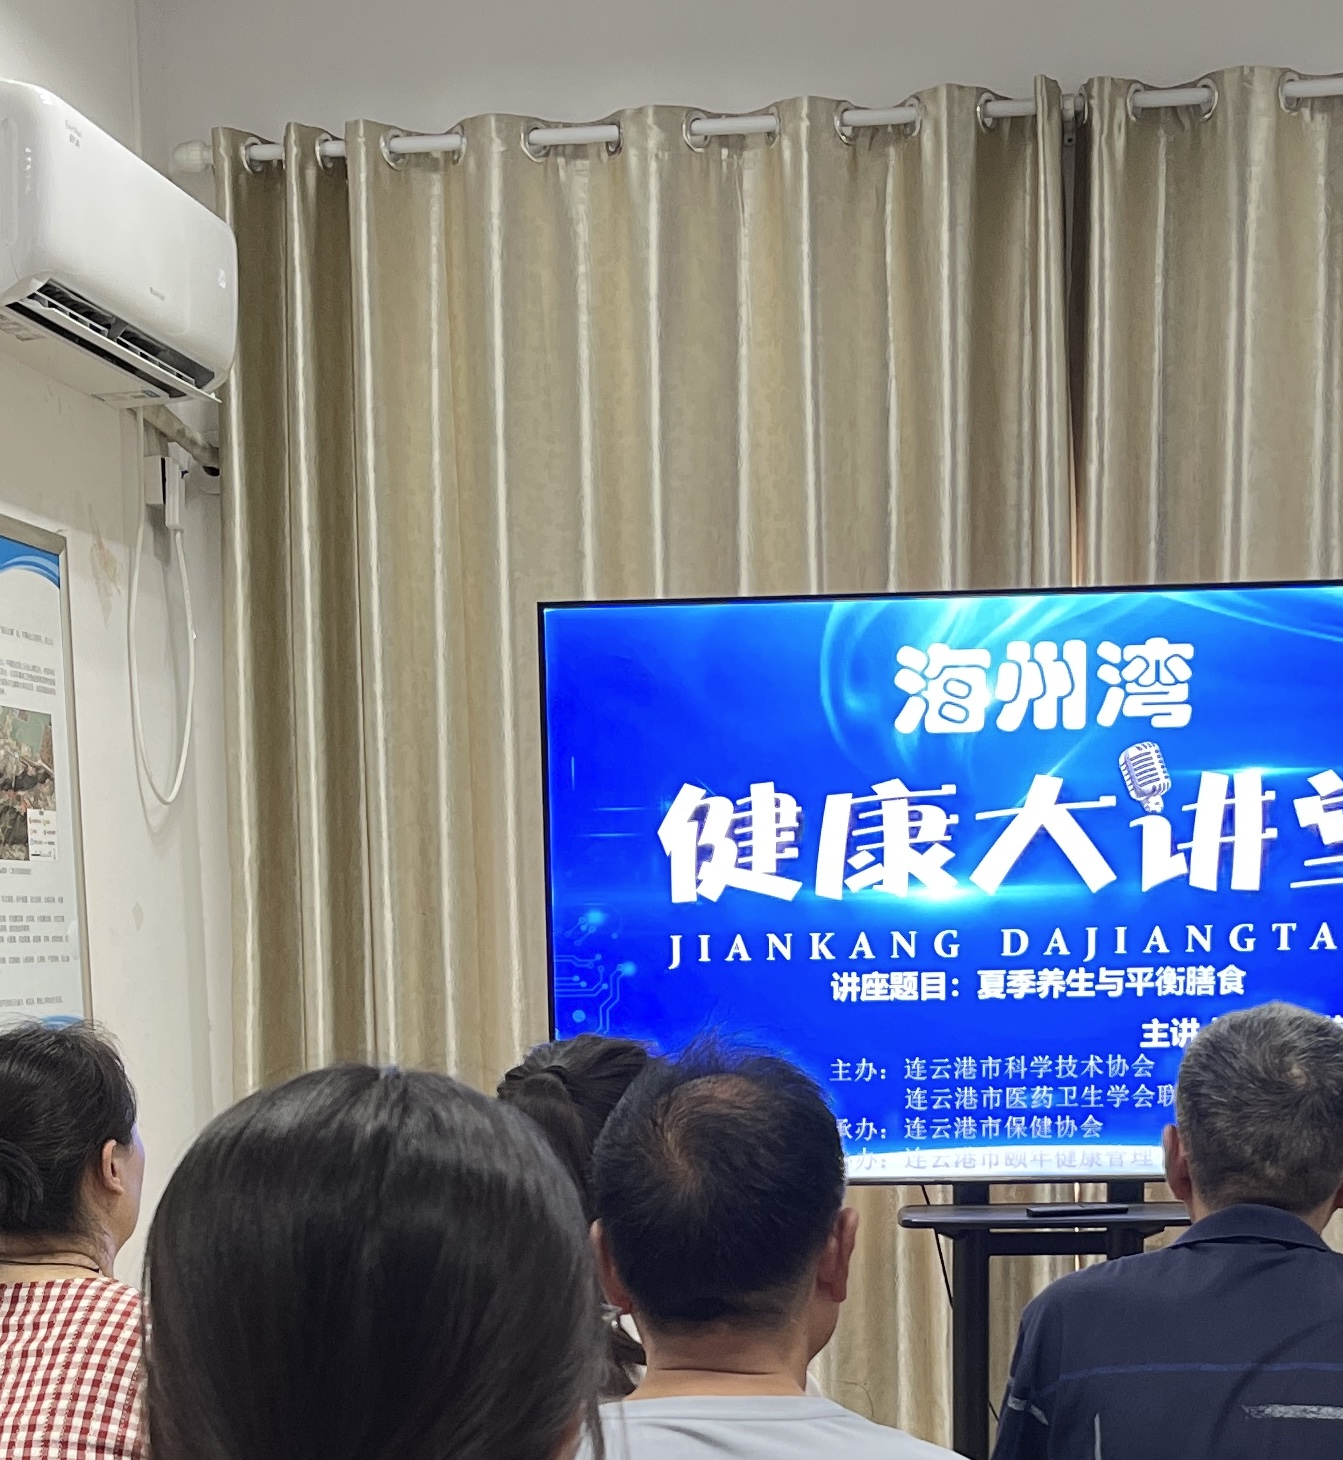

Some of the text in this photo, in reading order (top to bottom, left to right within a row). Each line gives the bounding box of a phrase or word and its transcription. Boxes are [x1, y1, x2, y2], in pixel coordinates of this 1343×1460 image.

[894, 636, 1196, 735] 海州湾
[667, 928, 964, 970] JIANKANG
[829, 965, 1248, 1003] 讲座题目：夏季养生与平衡膳食
[829, 1053, 1156, 1084] 主办：连云港市科学技术协会
